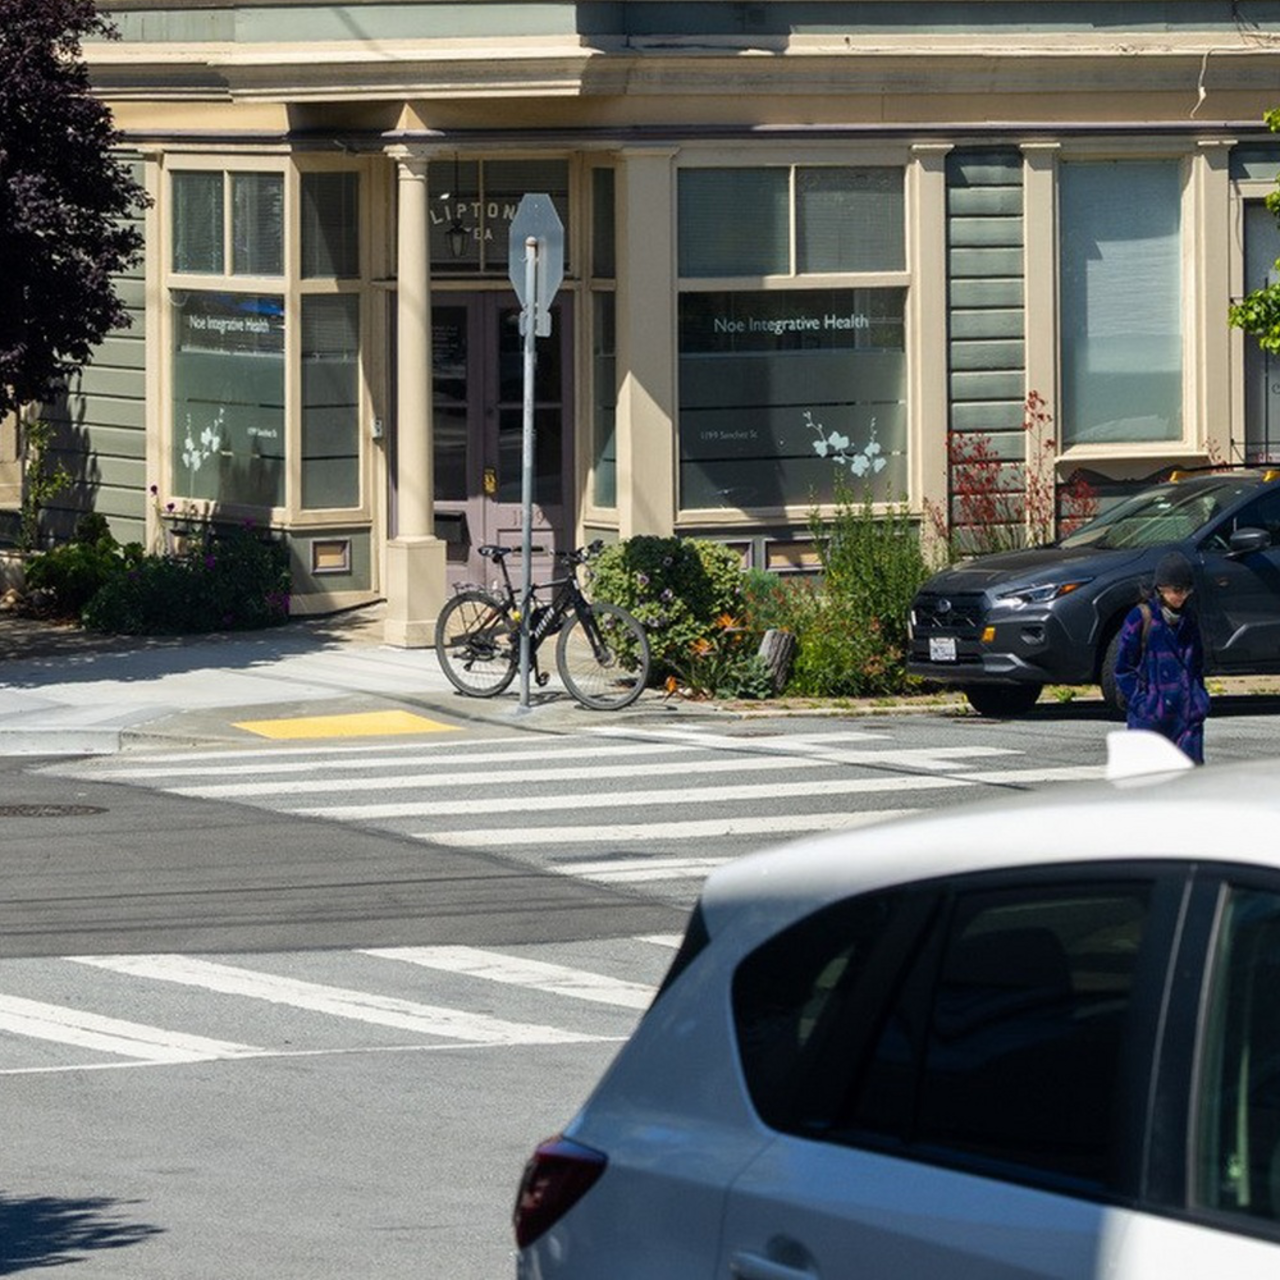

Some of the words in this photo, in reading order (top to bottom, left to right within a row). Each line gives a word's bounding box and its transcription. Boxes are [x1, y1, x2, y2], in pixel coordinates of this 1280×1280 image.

[429, 202, 516, 225] LIPTON
[189, 314, 206, 330] Noe
[713, 318, 745, 333] Noe
[749, 315, 820, 335] Integrative
[824, 314, 869, 330] Health
